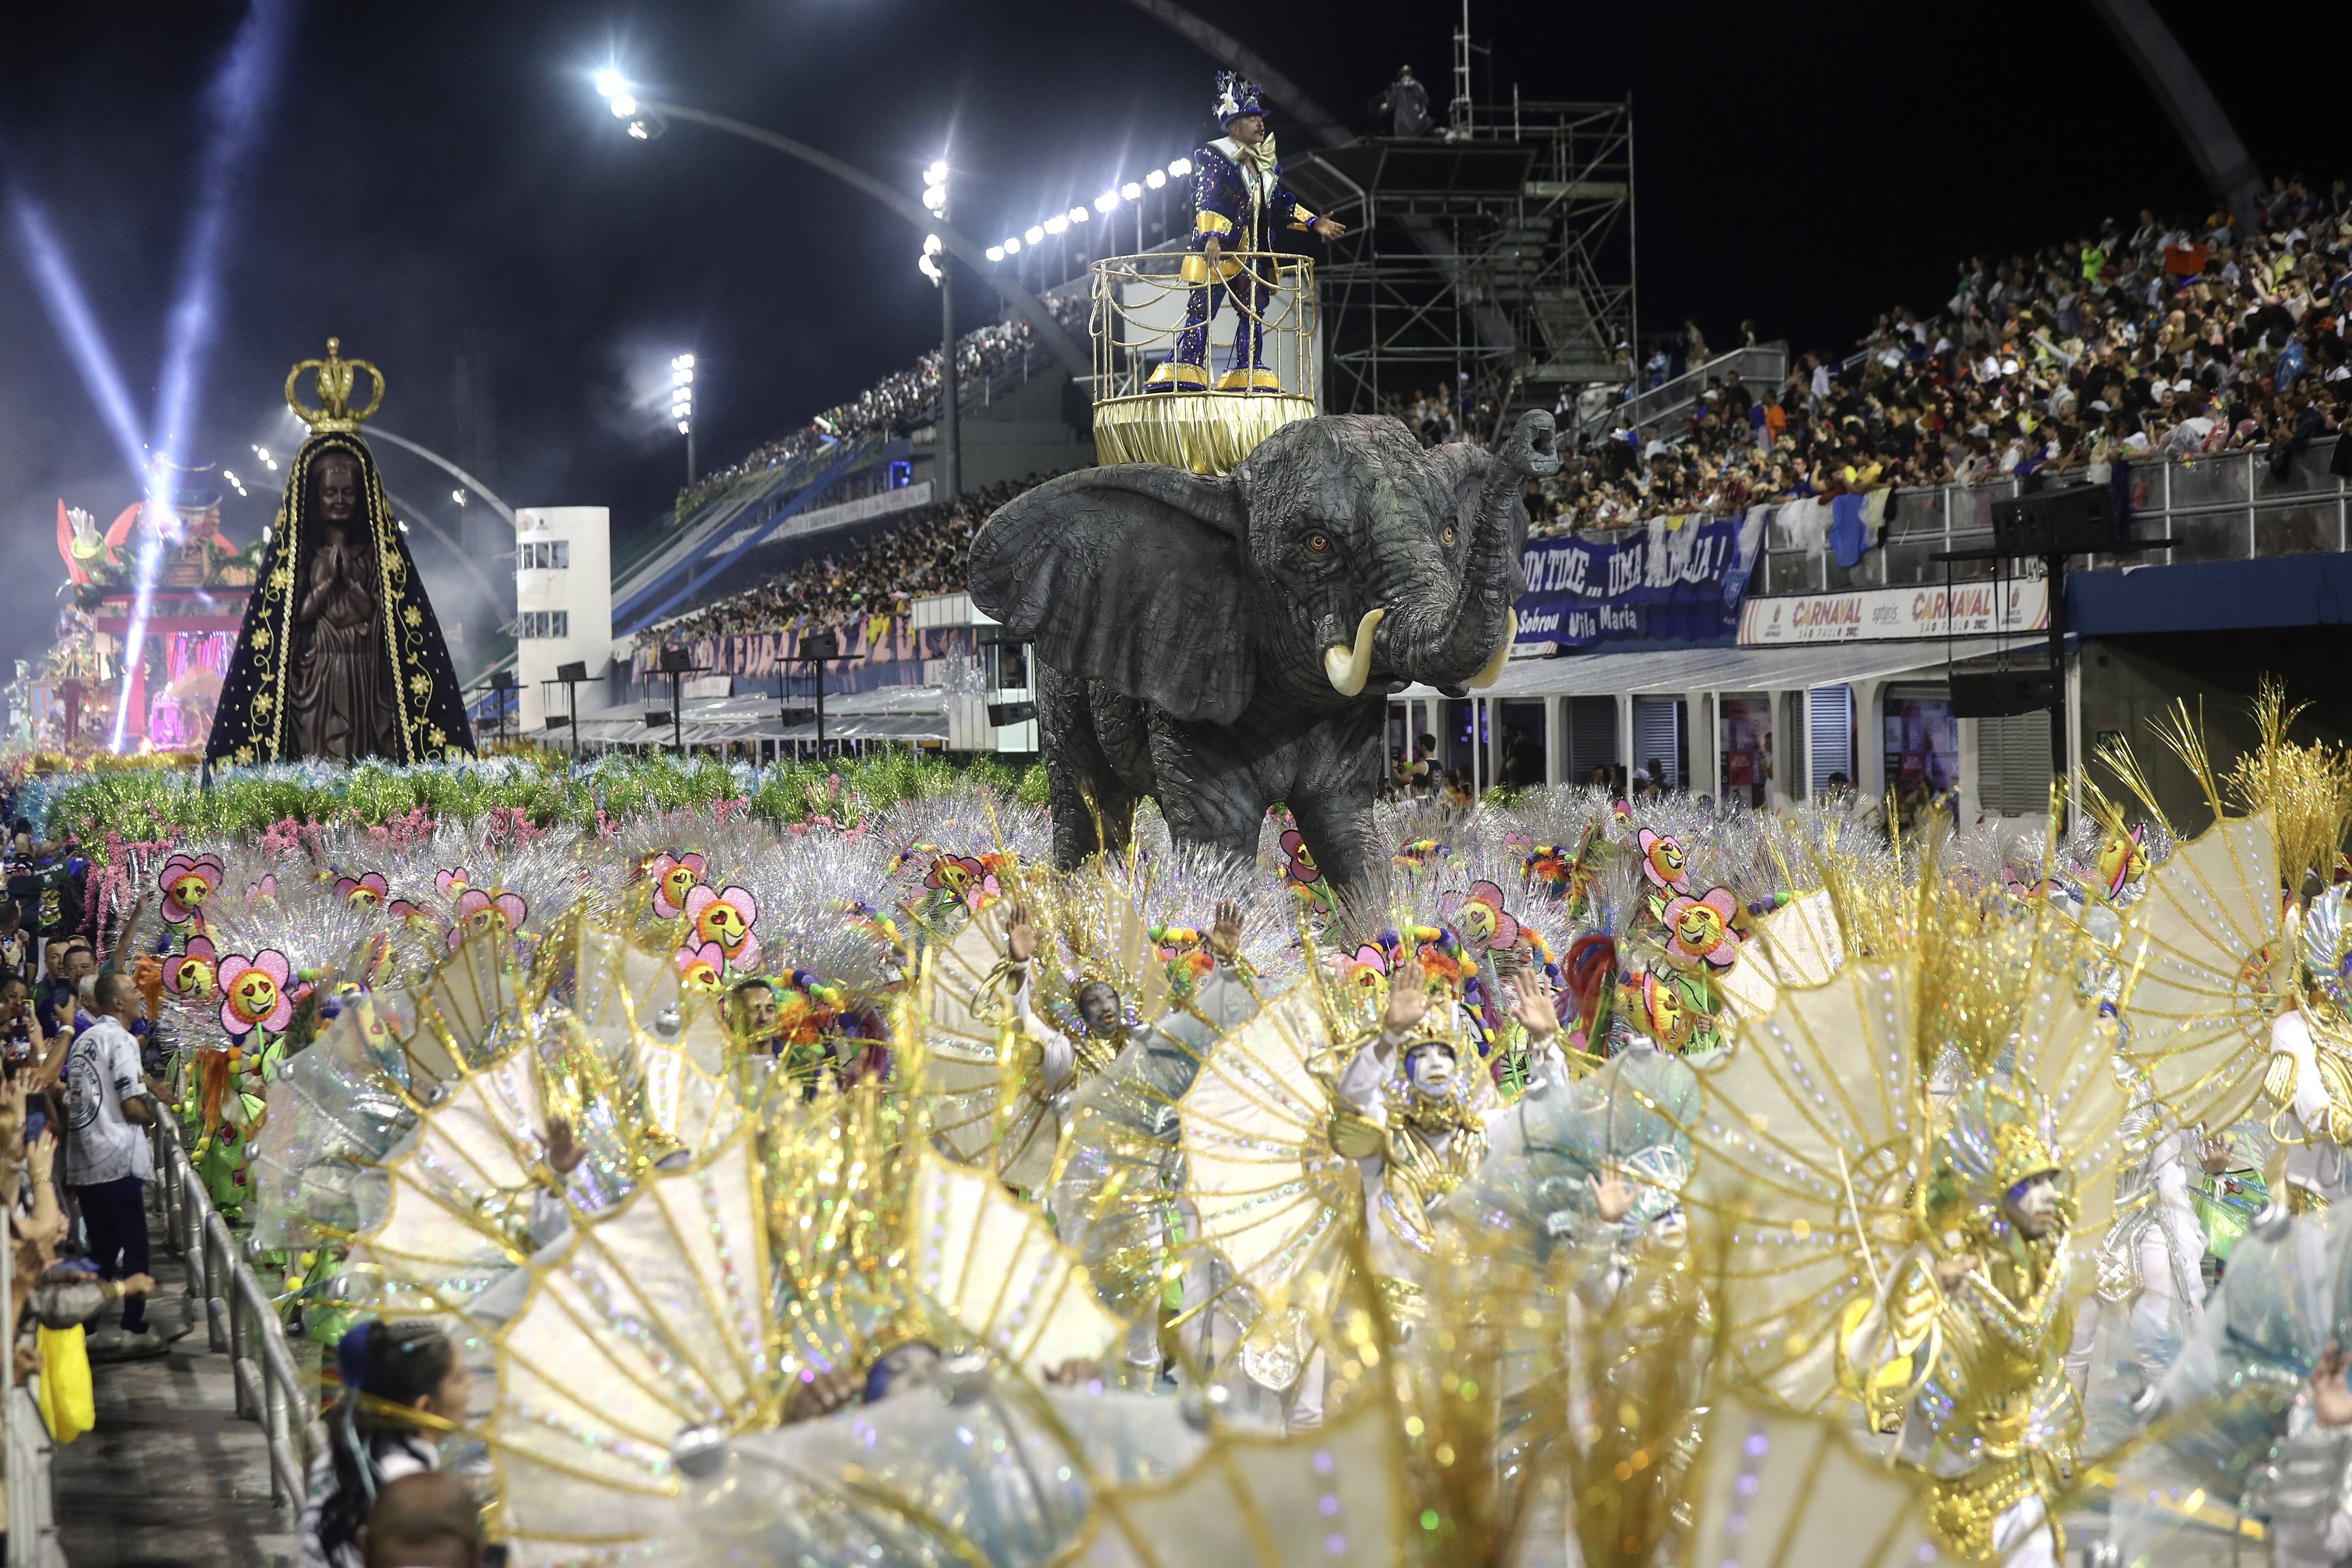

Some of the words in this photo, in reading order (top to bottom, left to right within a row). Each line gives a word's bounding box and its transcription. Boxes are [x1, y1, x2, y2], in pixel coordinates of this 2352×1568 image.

[1608, 543, 1642, 597] UMA
[1793, 598, 1862, 628] CARNAVAL
[1912, 588, 1991, 622] CARNAVAL
